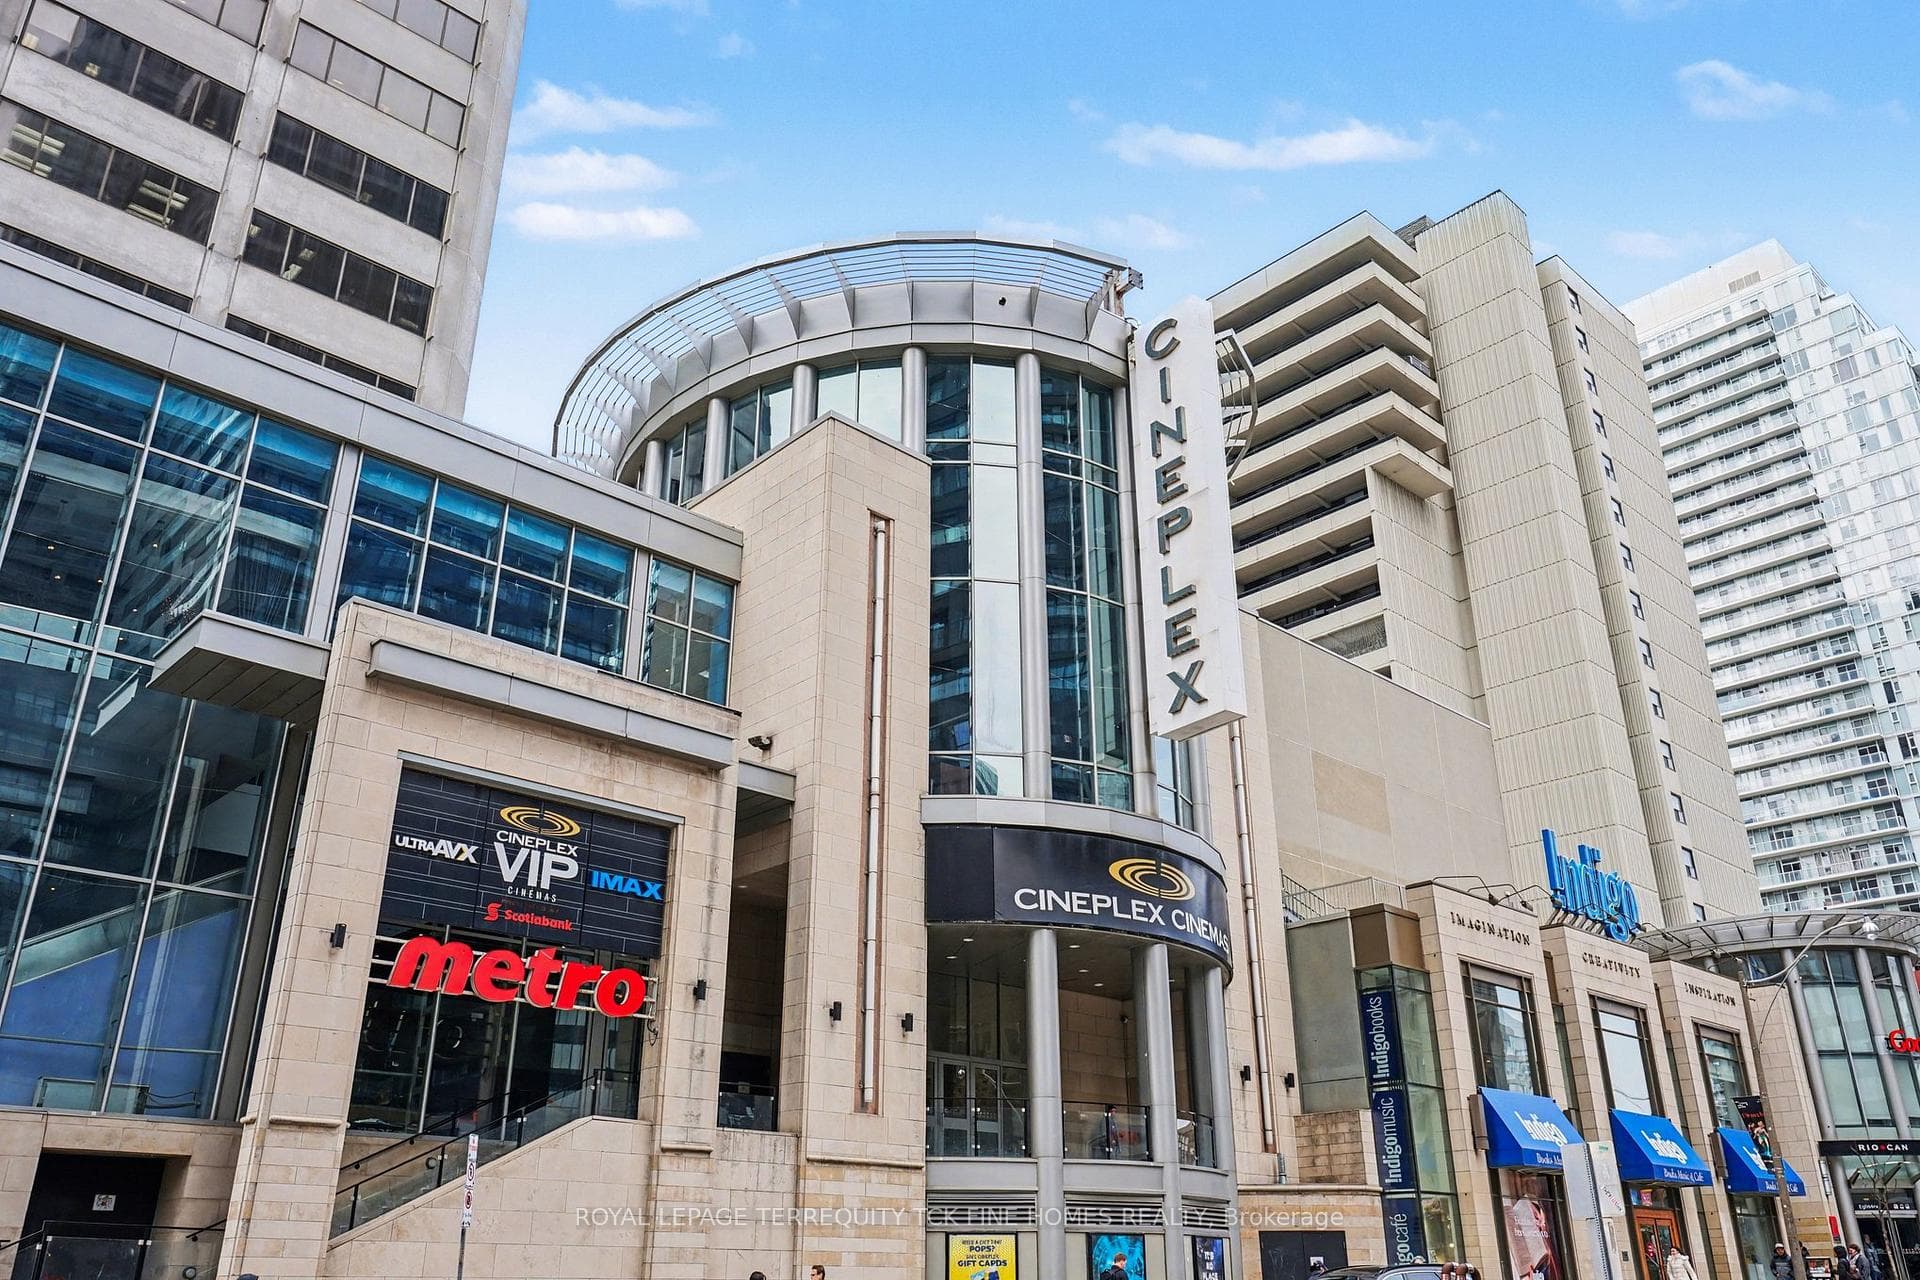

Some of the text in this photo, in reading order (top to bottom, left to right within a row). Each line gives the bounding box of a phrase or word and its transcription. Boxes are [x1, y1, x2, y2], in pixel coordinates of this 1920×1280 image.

[1144, 317, 1209, 716] CINEPLEX
[496, 830, 579, 858] CINEPLEX
[493, 841, 579, 890] VIP
[507, 885, 557, 903] CINEMAS
[591, 870, 665, 901] IMAX
[504, 909, 573, 931] Scotiabank
[1013, 887, 1231, 956] CINEPLEX CINEMAS
[1450, 911, 1531, 946] IMAGINATION
[387, 937, 647, 1018] metro
[1582, 952, 1641, 979] CREATIVITY
[1684, 982, 1737, 1008] INSPIRATION
[1858, 1143, 1909, 1152] RIO CAN
[978, 1259, 1008, 1267] CARDS
